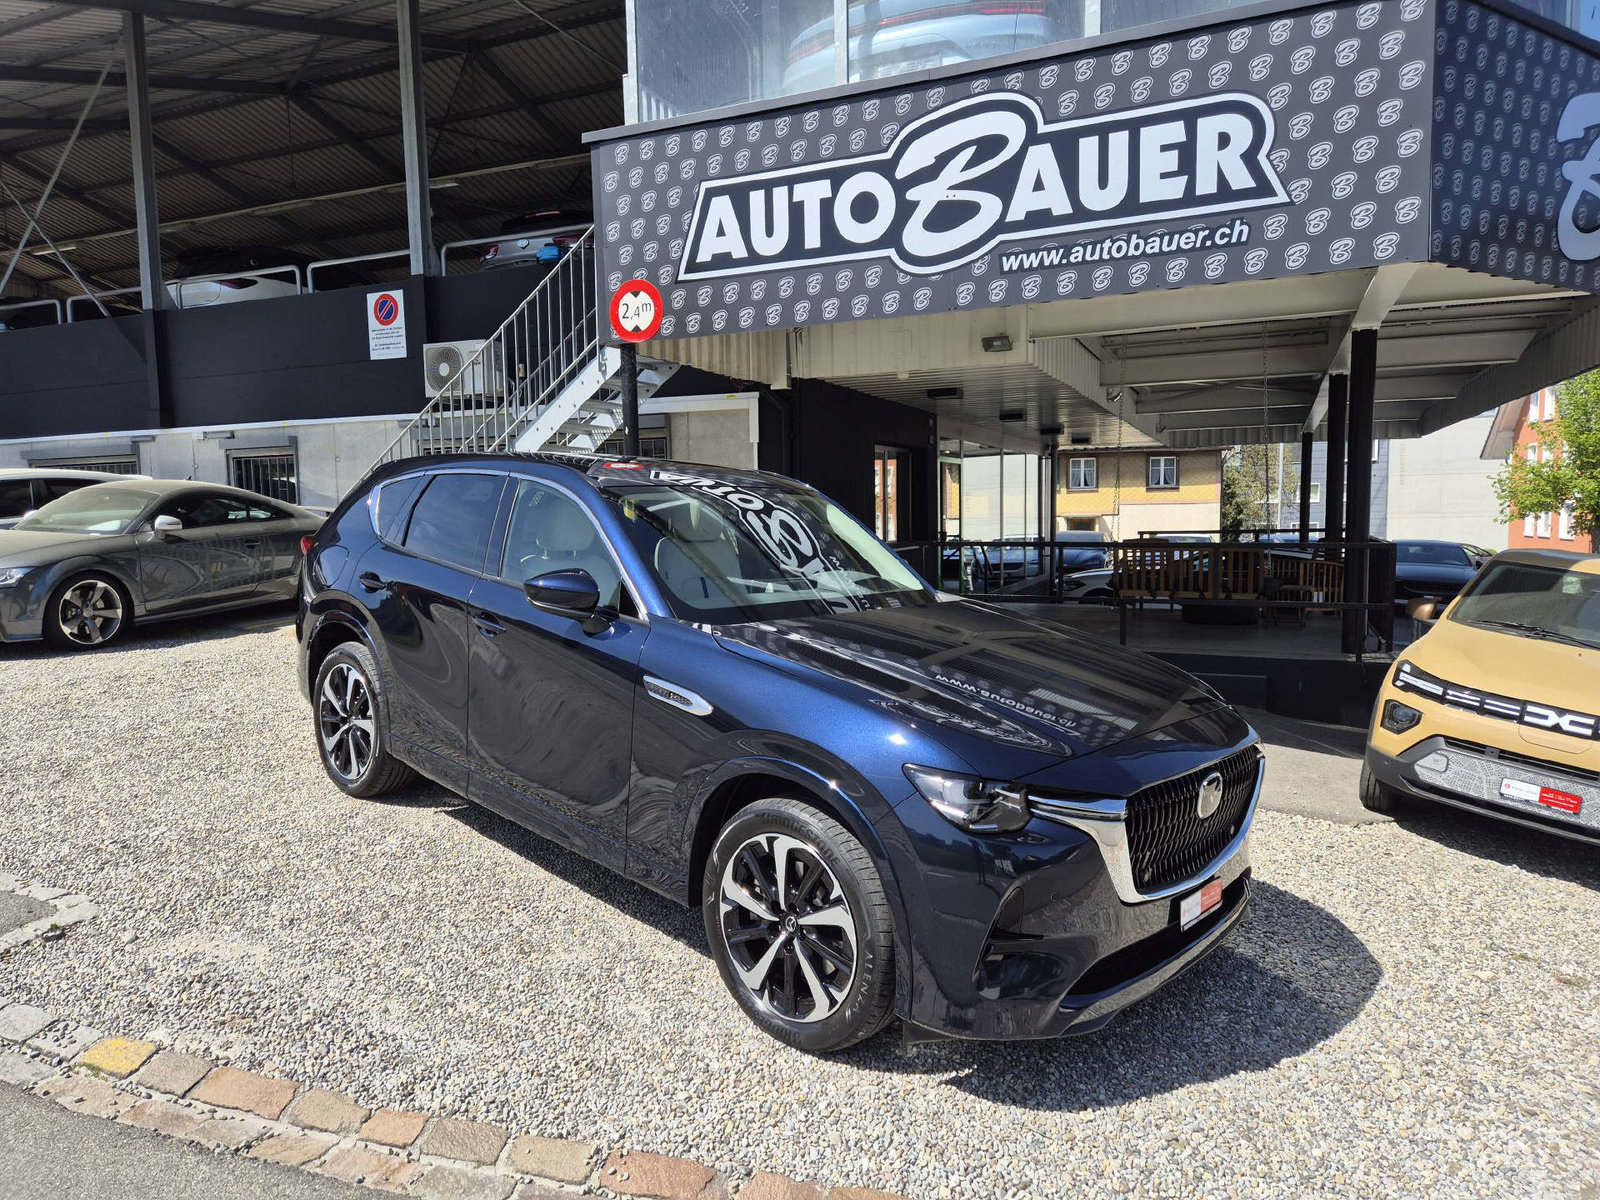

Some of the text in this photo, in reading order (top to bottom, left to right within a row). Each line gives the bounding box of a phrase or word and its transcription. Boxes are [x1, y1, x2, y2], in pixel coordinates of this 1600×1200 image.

[695, 110, 1257, 264] AUTO BAUER
[1001, 220, 1251, 274] www.autobauer.ch
